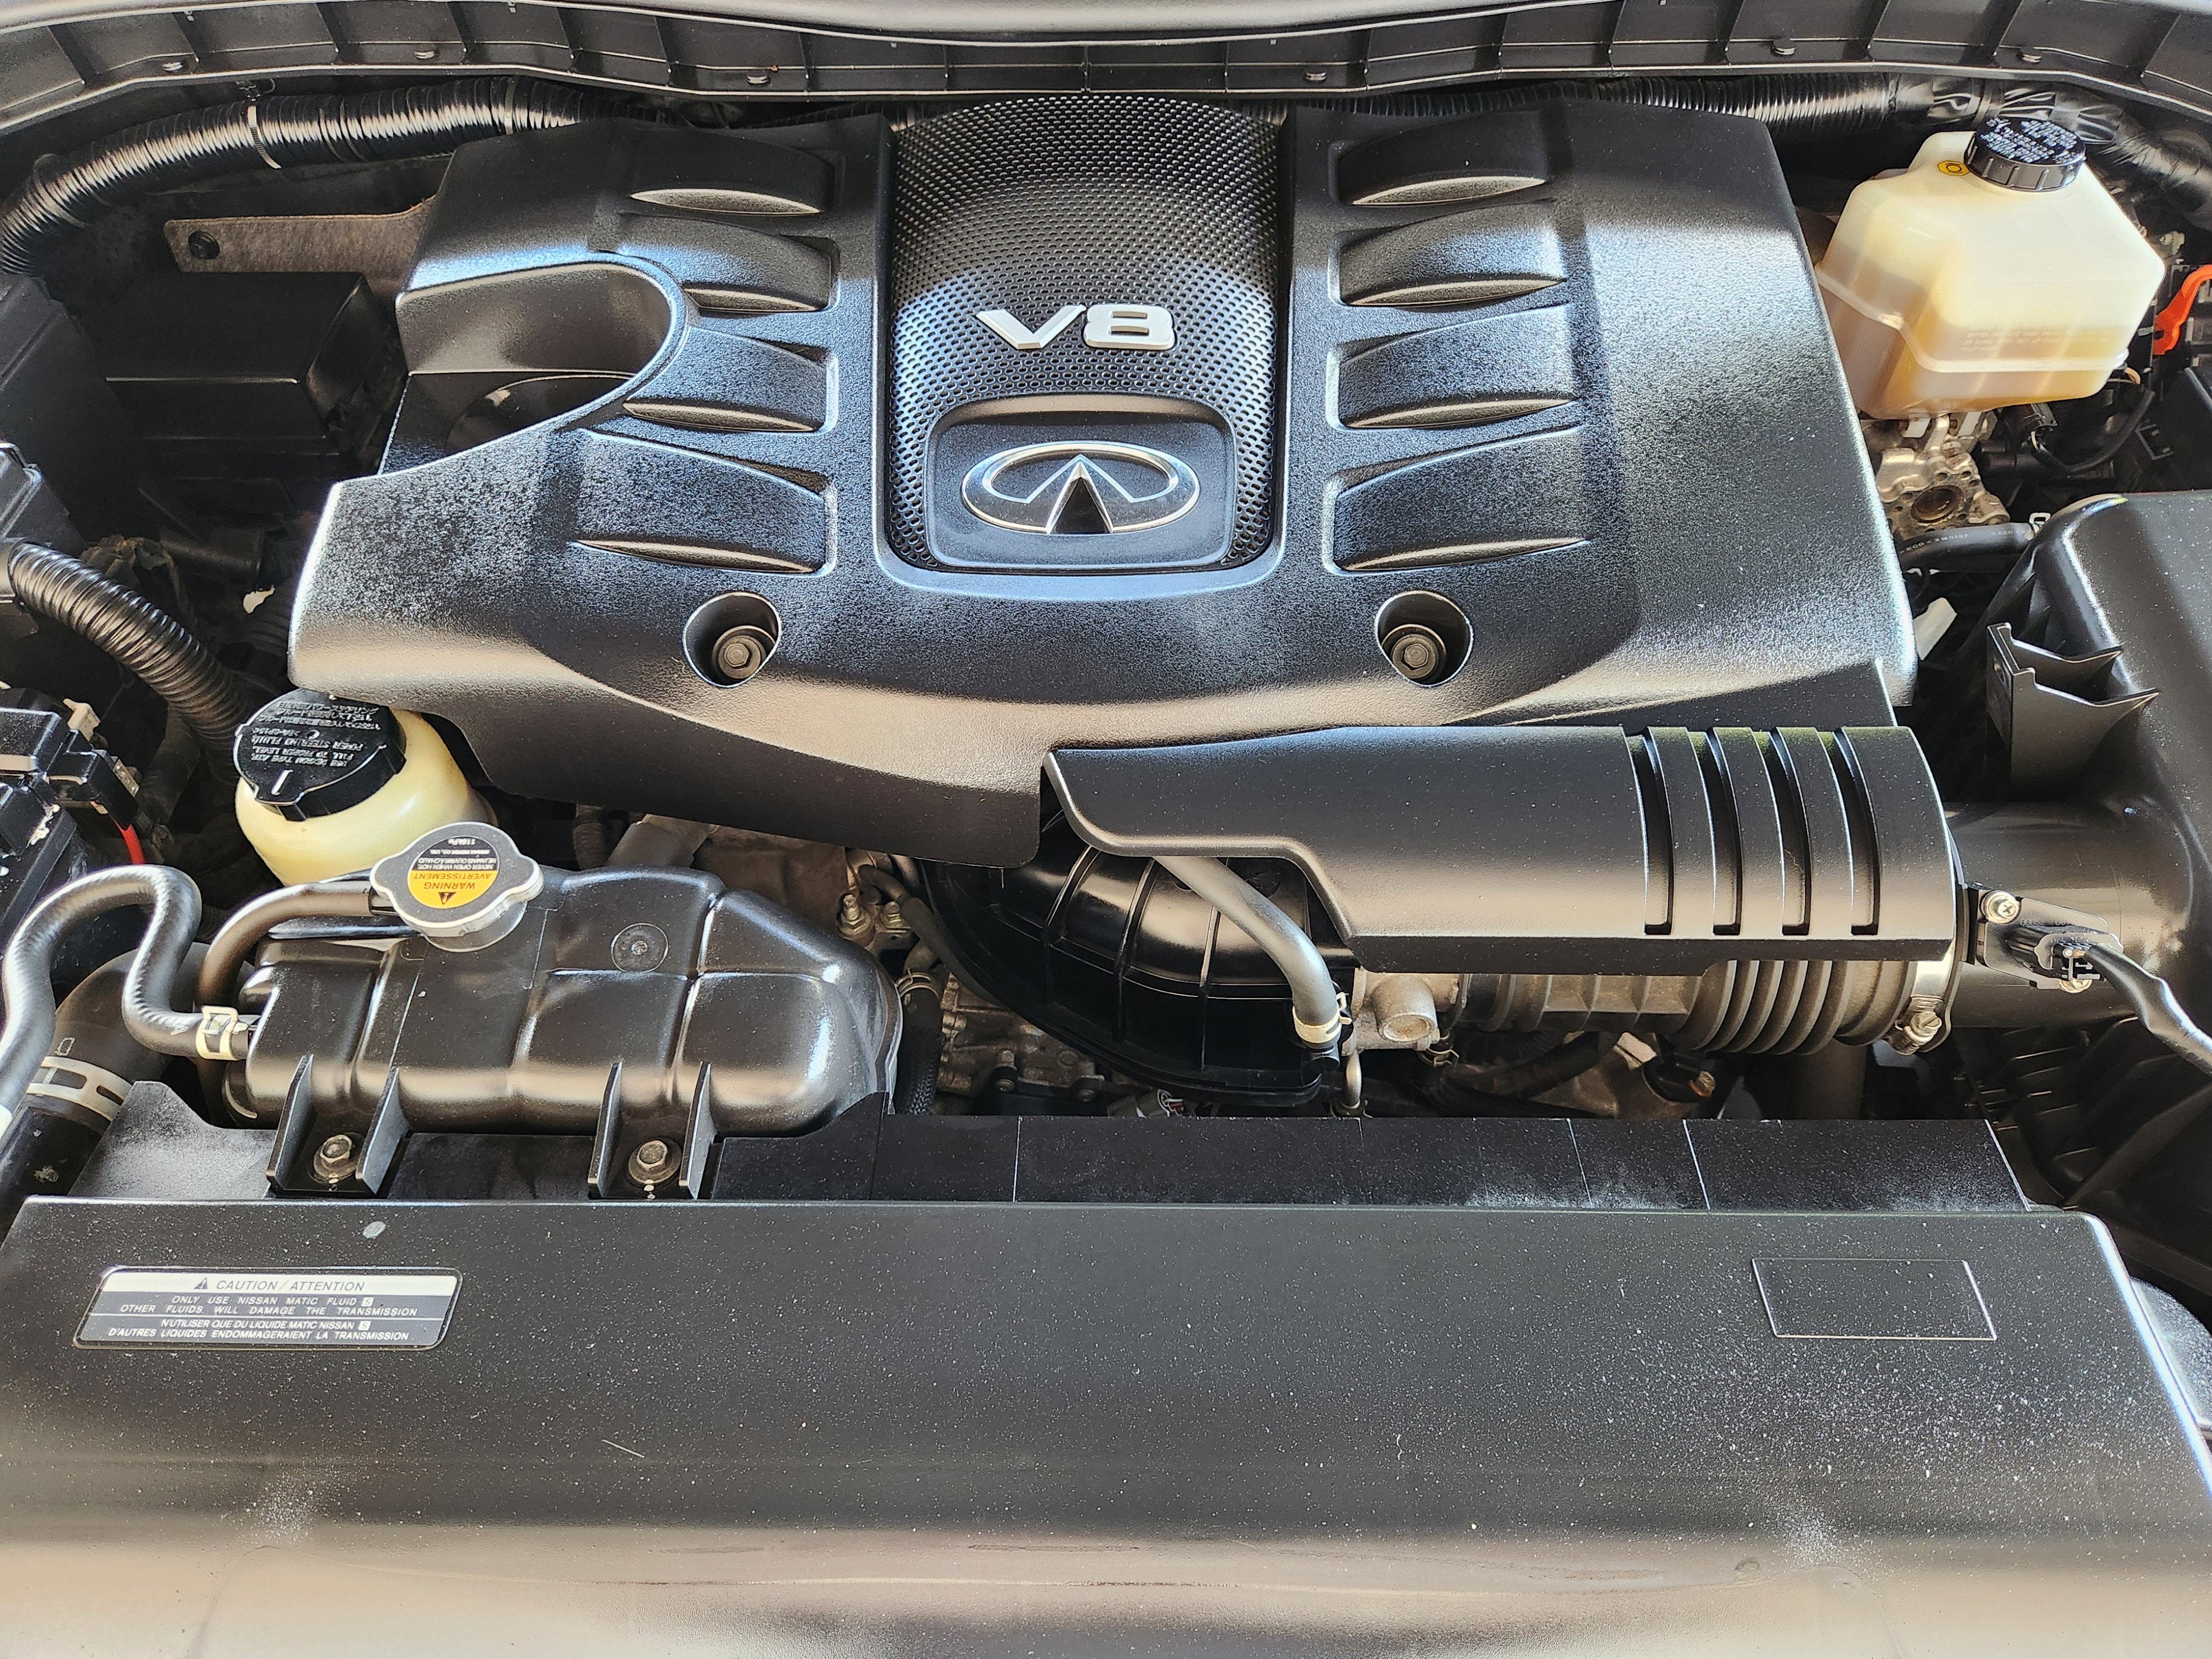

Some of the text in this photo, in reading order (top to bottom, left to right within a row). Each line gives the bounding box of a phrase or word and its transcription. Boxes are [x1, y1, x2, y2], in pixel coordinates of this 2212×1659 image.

[975, 304, 1175, 349] V8
[216, 1280, 278, 1291] CAUTION
[289, 1281, 366, 1291] ATTENTION
[171, 1295, 201, 1304] ONLY
[207, 1296, 230, 1305] USE
[237, 1296, 278, 1305] NISSAN
[285, 1297, 319, 1306] MATIC
[326, 1297, 357, 1306] FLUID
[119, 1304, 156, 1313] OTHER
[213, 1306, 239, 1314] WILL
[249, 1306, 296, 1316] DAMAGE
[305, 1307, 327, 1315] THE
[336, 1307, 419, 1317] TRANSMISSION
[160, 1318, 210, 1328] N'UTILISER
[211, 1319, 234, 1329] QUE
[234, 1320, 248, 1328] DU
[249, 1321, 288, 1329] LIQUIDE
[288, 1321, 318, 1329] MATIC
[319, 1321, 356, 1330] NISSAN
[107, 1328, 409, 1341] D'AUTRES LIQUIDES ENDOMMAGERAIENT LA TRANSMISSION
